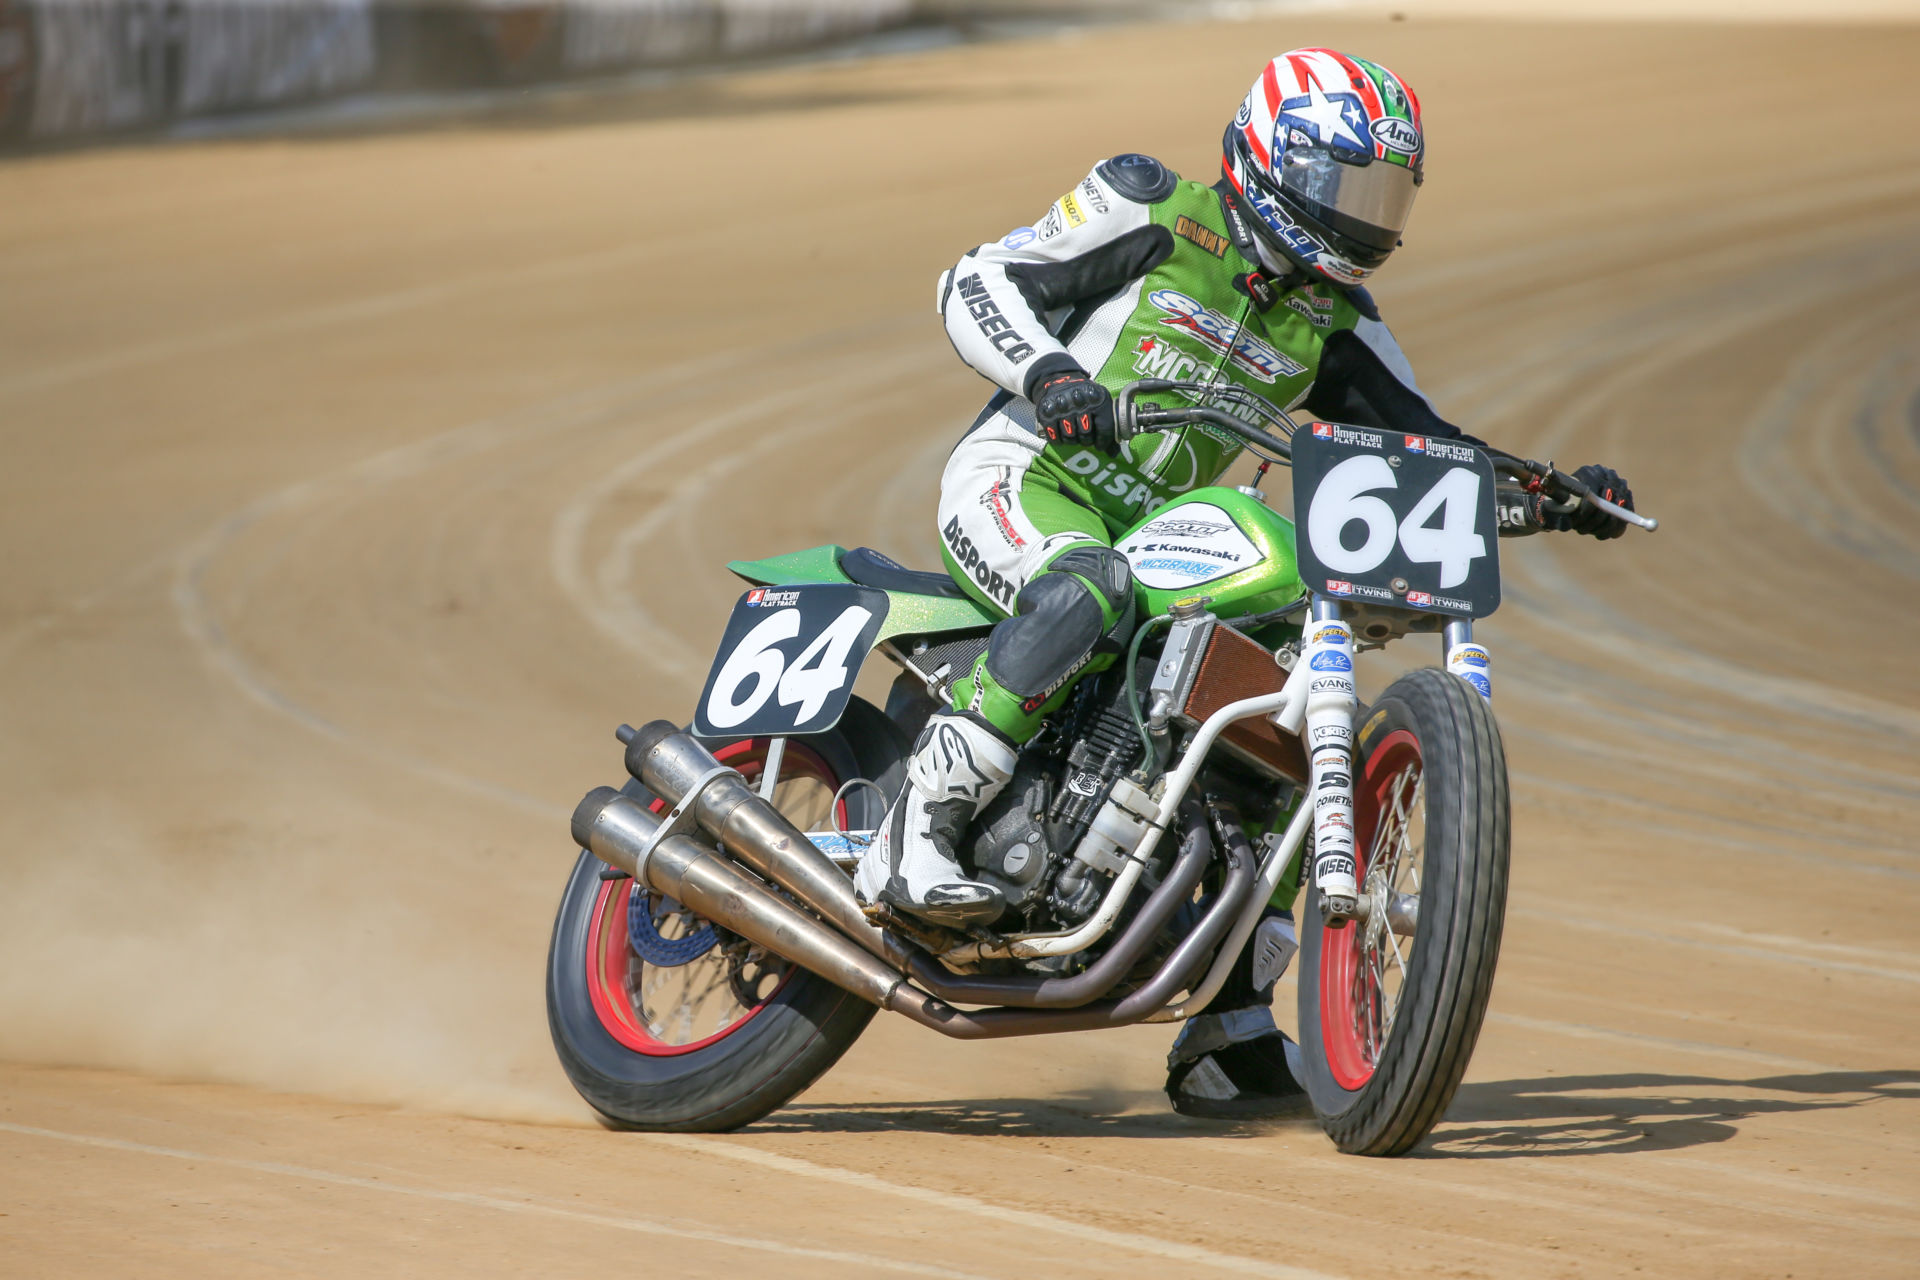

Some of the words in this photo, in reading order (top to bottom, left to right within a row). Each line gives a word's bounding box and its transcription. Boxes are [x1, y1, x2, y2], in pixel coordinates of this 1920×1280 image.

[1374, 121, 1417, 147] Arai
[1176, 216, 1231, 258] DANNY
[956, 272, 1034, 360] WISECO
[1333, 425, 1383, 444] American
[1333, 437, 1354, 446] FLAT
[1356, 440, 1383, 449] TRACK
[1426, 439, 1474, 457] American
[1426, 451, 1447, 459] FLAT
[1448, 454, 1474, 463] TRACK
[1308, 454, 1487, 589] 64
[1158, 543, 1241, 562] Kawasaki
[762, 589, 800, 601] American
[1356, 586, 1392, 598] TWINS
[1436, 598, 1471, 610] TWINS
[707, 605, 872, 728] 64
[1312, 679, 1353, 691] EVANS
[1313, 724, 1352, 742] VORTEX
